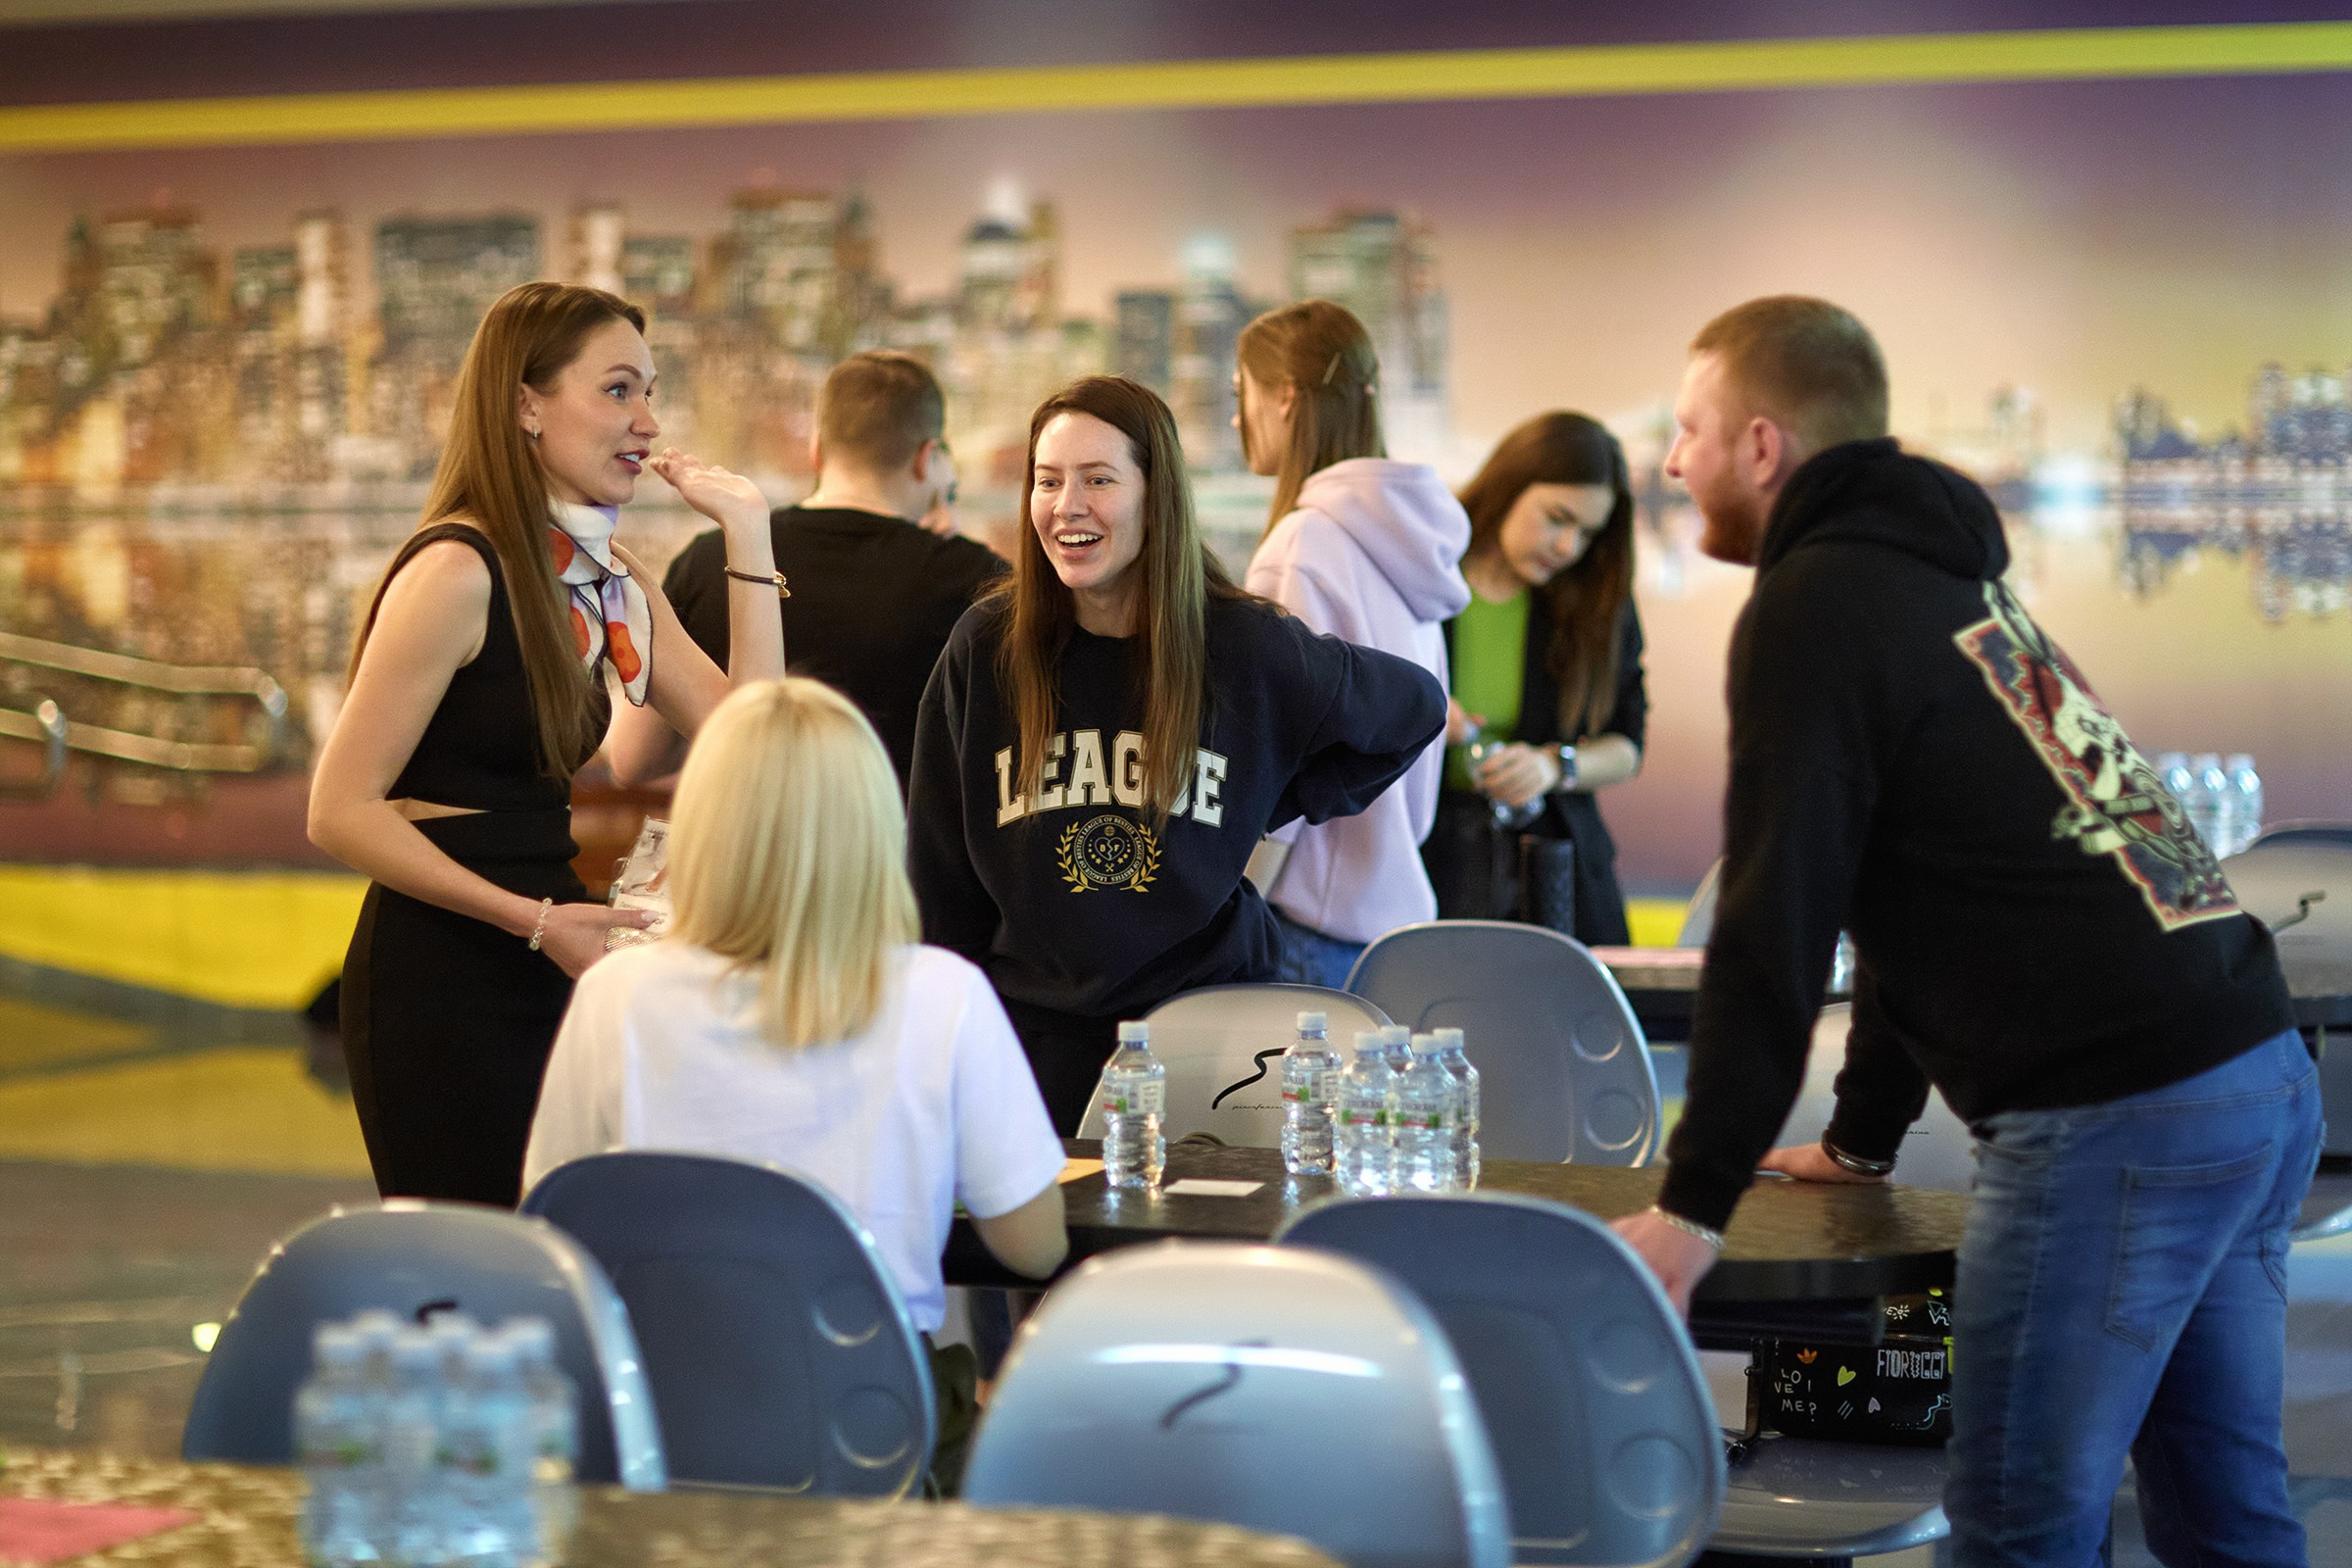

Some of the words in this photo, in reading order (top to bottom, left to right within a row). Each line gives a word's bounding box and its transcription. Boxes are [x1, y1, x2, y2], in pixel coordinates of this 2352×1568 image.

[1081, 817, 1103, 836] LEAGUE
[1113, 817, 1135, 835] BESTIES
[1113, 844, 1120, 853] F
[1878, 1349, 1944, 1379] FIORUCCI
[1781, 1368, 1801, 1384] LO
[1774, 1382, 1794, 1394] VE
